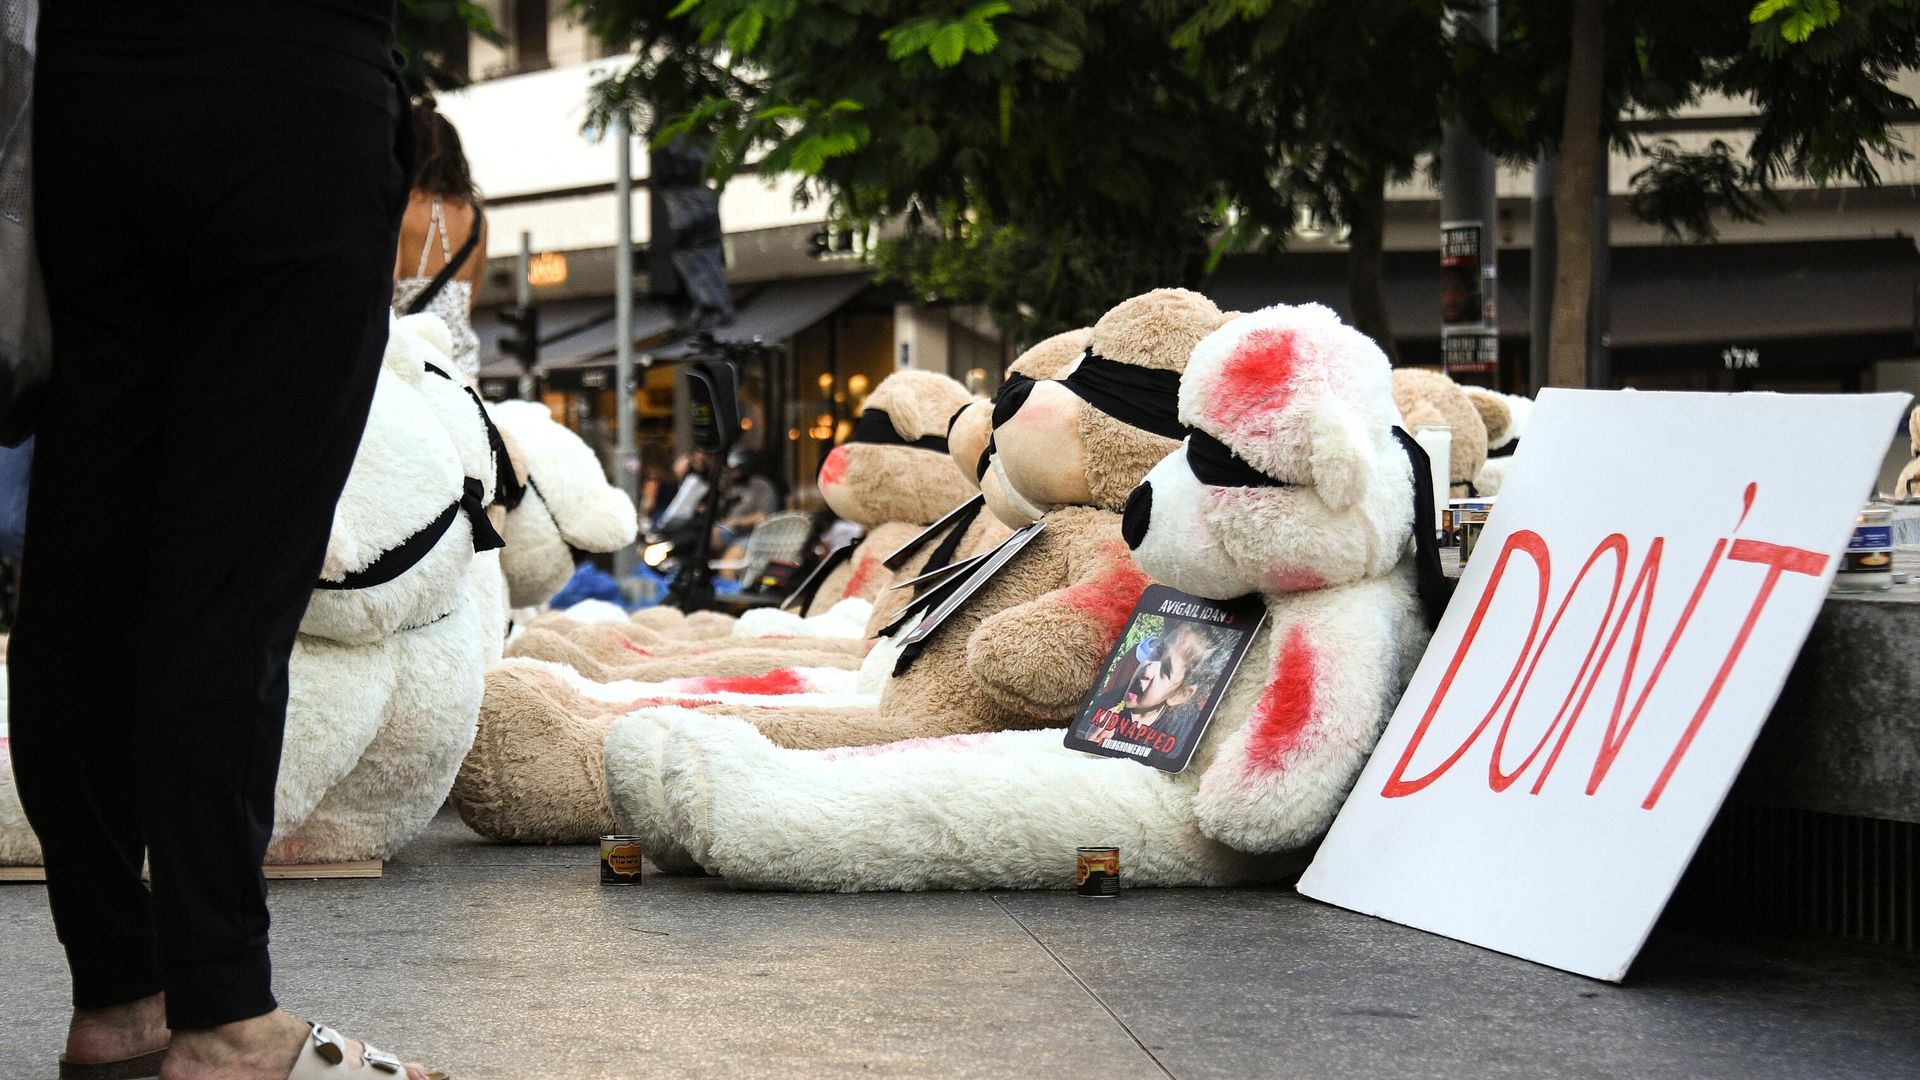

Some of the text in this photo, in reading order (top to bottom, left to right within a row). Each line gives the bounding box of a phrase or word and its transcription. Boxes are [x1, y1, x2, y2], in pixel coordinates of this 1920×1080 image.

[1158, 599, 1200, 618] AVIGAIL
[1199, 606, 1228, 623] IDAN
[1380, 481, 1830, 811] DON'T
[1091, 708, 1178, 754] KIDNAPPED
